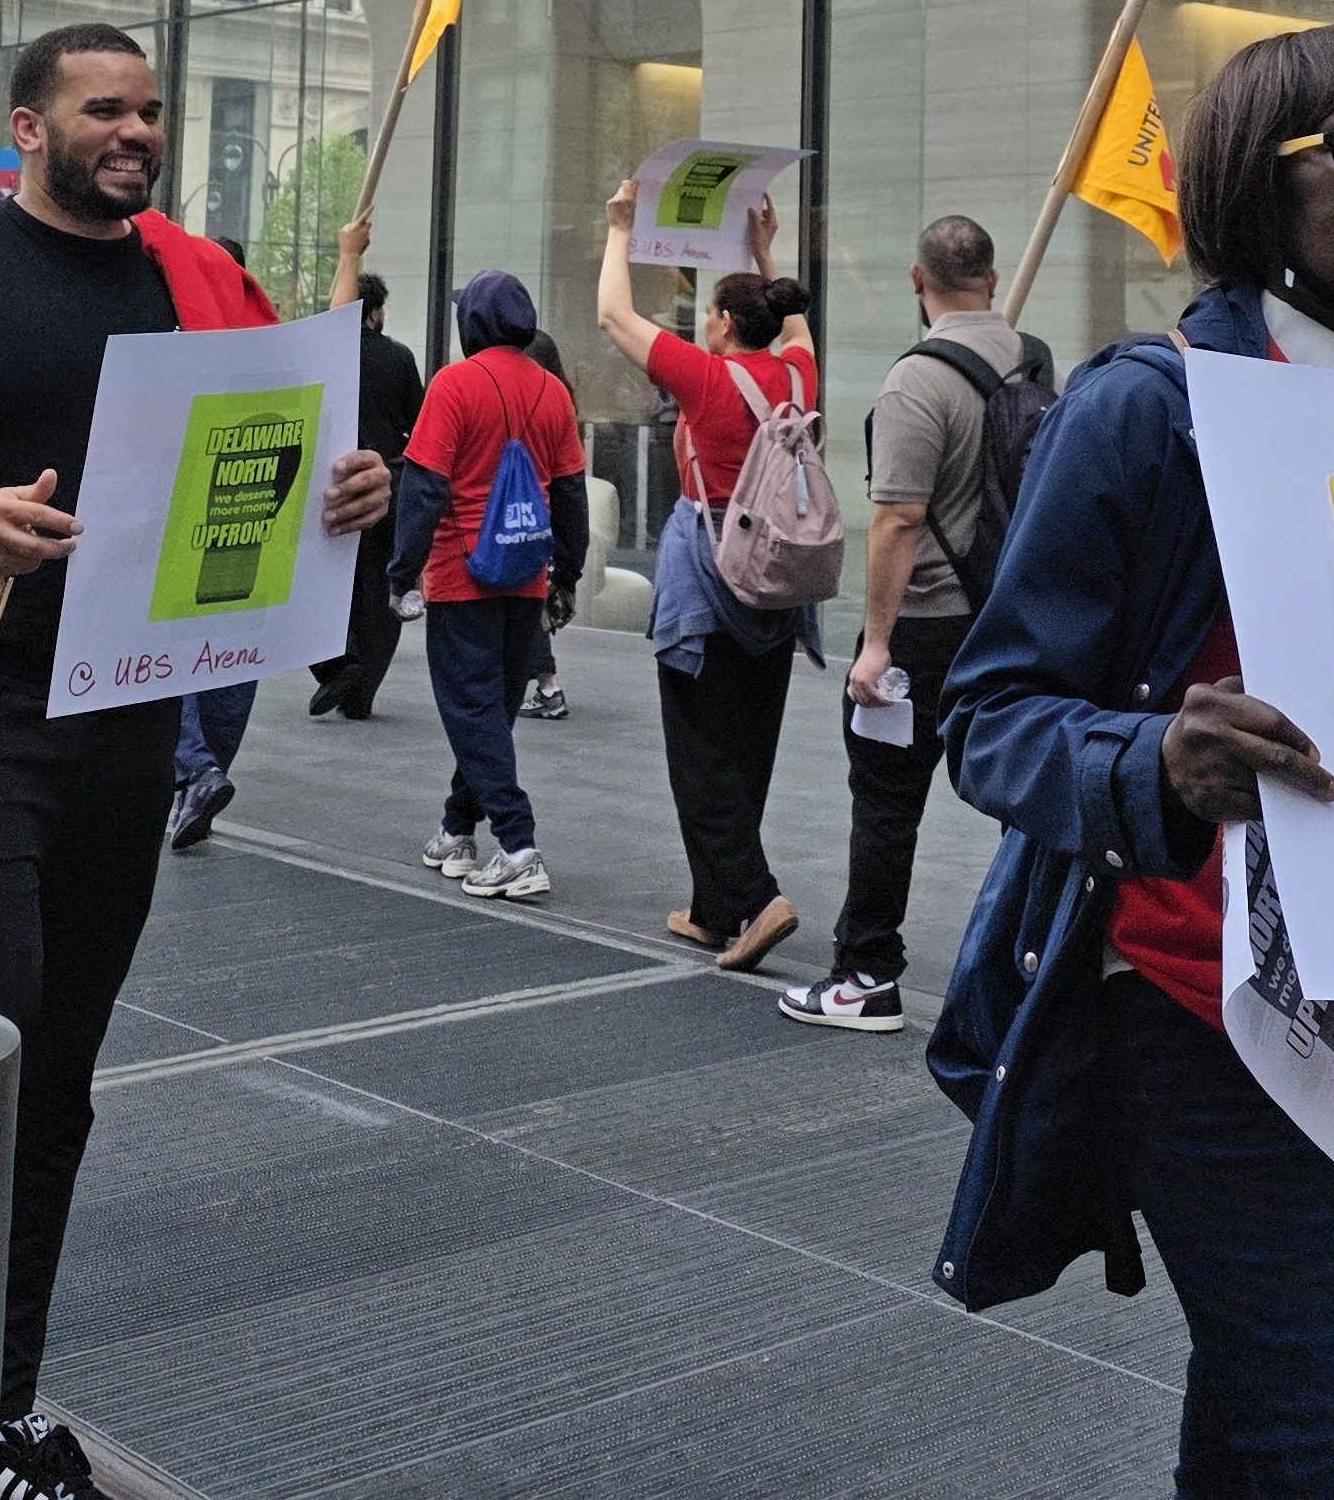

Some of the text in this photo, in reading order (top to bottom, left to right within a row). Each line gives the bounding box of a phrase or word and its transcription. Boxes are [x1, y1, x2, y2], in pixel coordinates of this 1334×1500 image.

[205, 419, 304, 455] DELAWARE
[214, 455, 280, 487] NORTH
[209, 500, 279, 517] more money
[214, 489, 277, 504] we deserve
[191, 517, 277, 550] UPFRONT
[68, 639, 267, 697] @ UBS Arena
